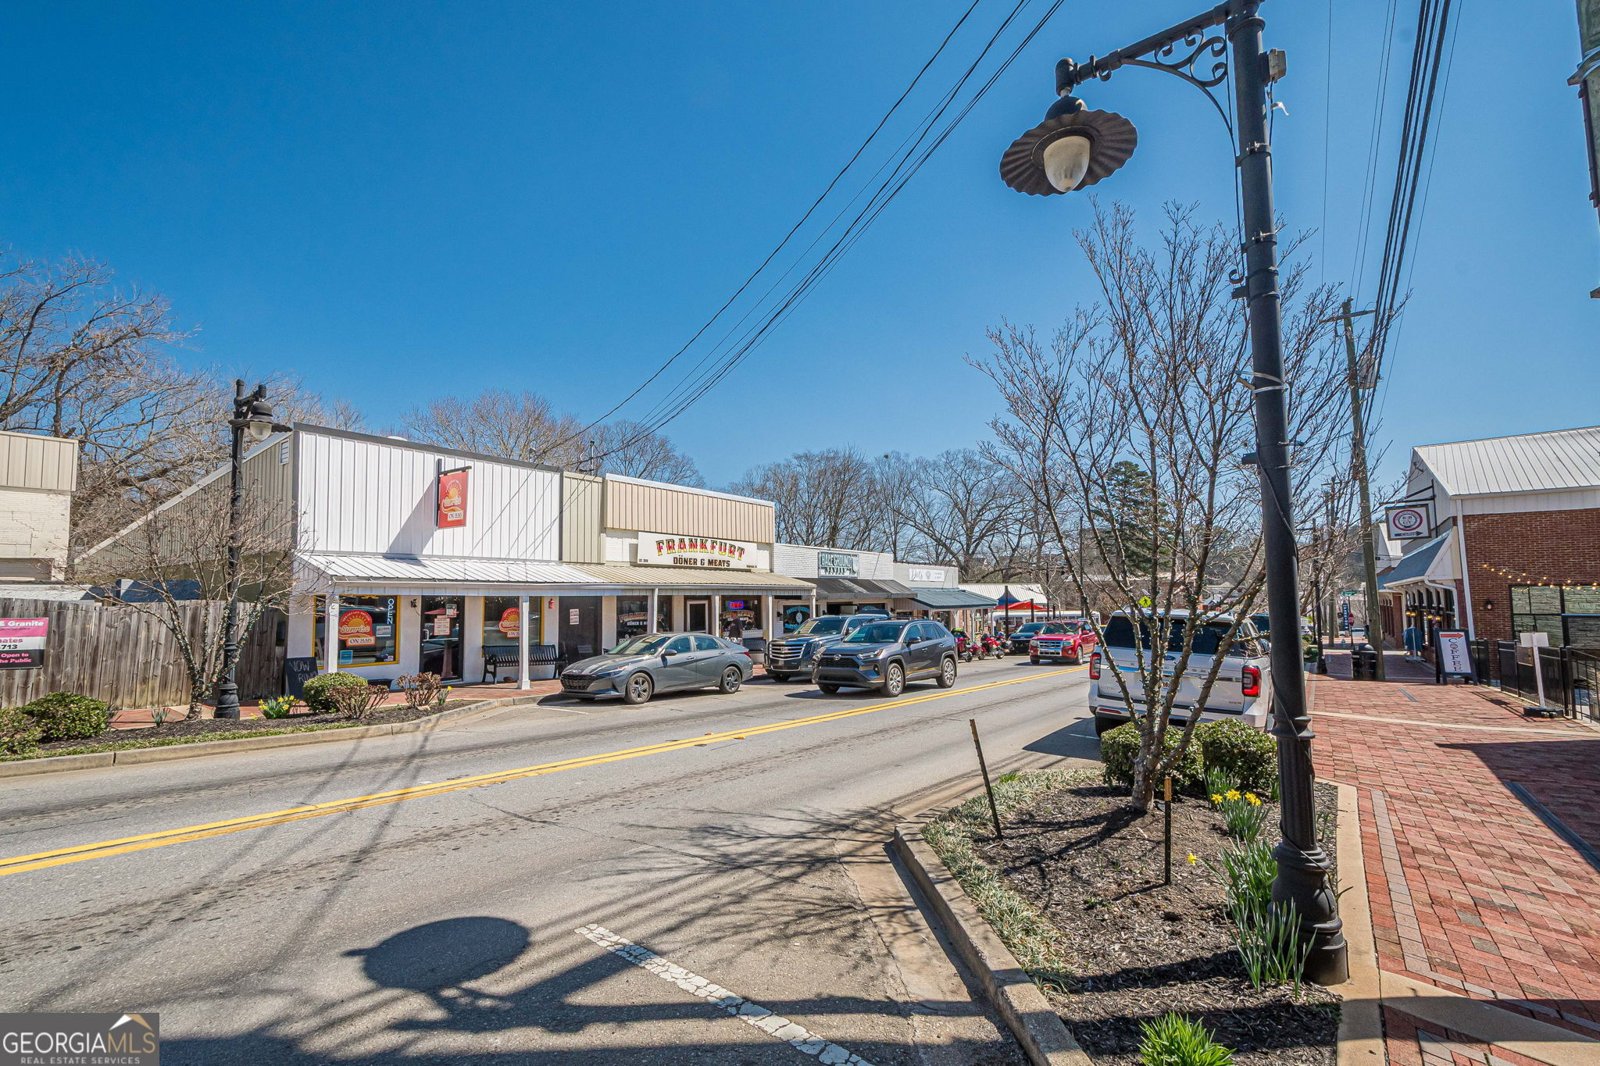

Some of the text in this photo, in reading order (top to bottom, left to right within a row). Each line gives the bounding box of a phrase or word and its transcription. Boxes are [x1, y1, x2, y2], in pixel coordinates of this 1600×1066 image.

[655, 537, 745, 561] FRANKFURT
[673, 554, 698, 567] DÖNER
[707, 558, 731, 568] MEATS
[387, 598, 395, 625] OPEN
[1448, 637, 1463, 672] COFFEE
